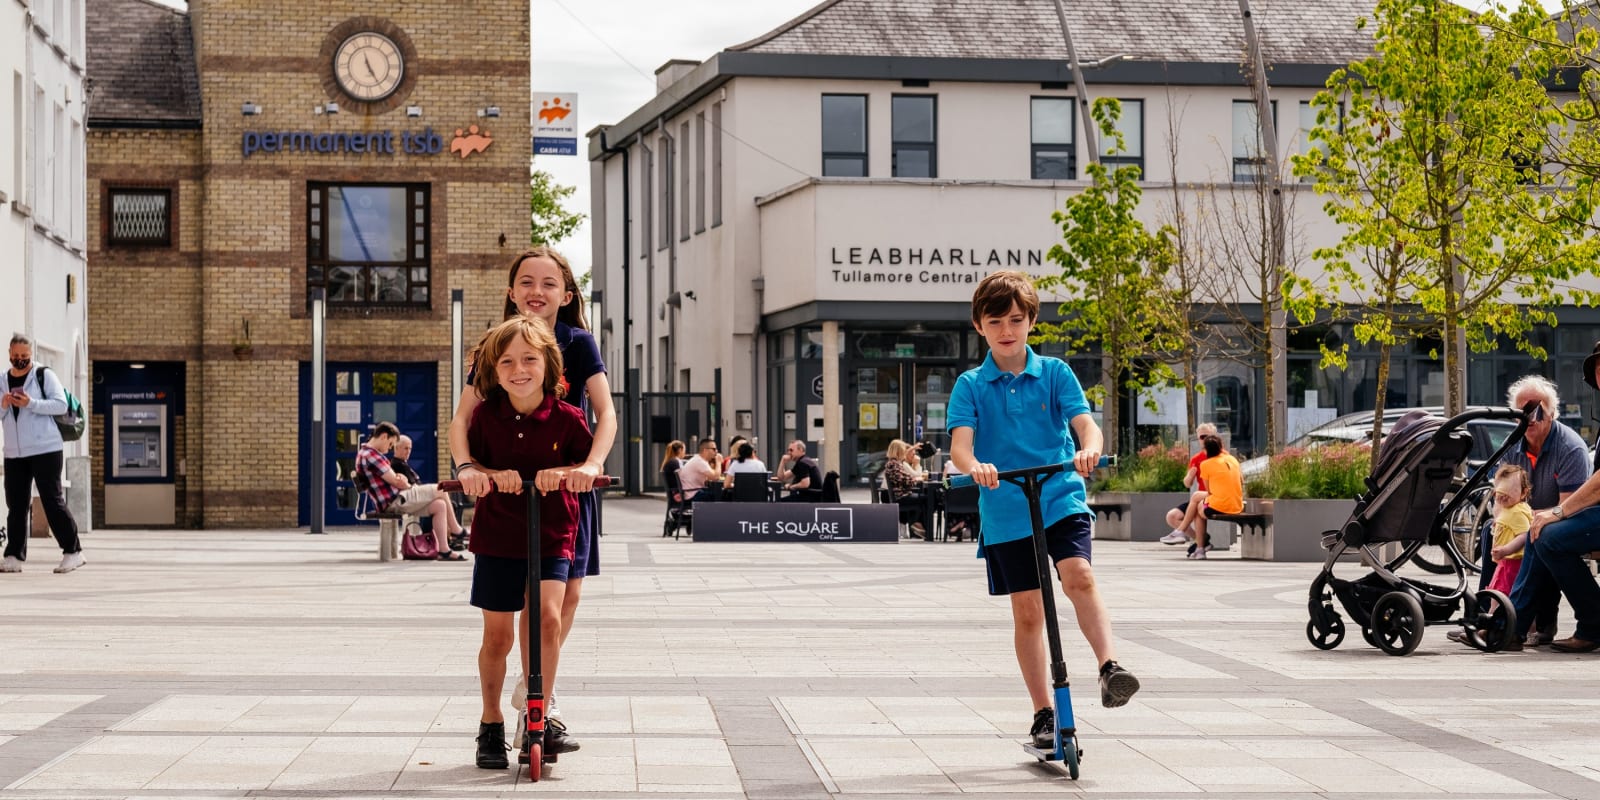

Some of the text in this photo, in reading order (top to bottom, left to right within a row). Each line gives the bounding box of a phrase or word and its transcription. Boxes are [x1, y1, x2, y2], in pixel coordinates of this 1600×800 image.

[243, 127, 443, 156] permanent tsb
[832, 248, 1042, 266] LEABHARLANN
[832, 270, 913, 283] Tullamore
[919, 270, 978, 283] Central
[112, 392, 145, 400] permanent
[738, 521, 839, 536] THE SQUARE
